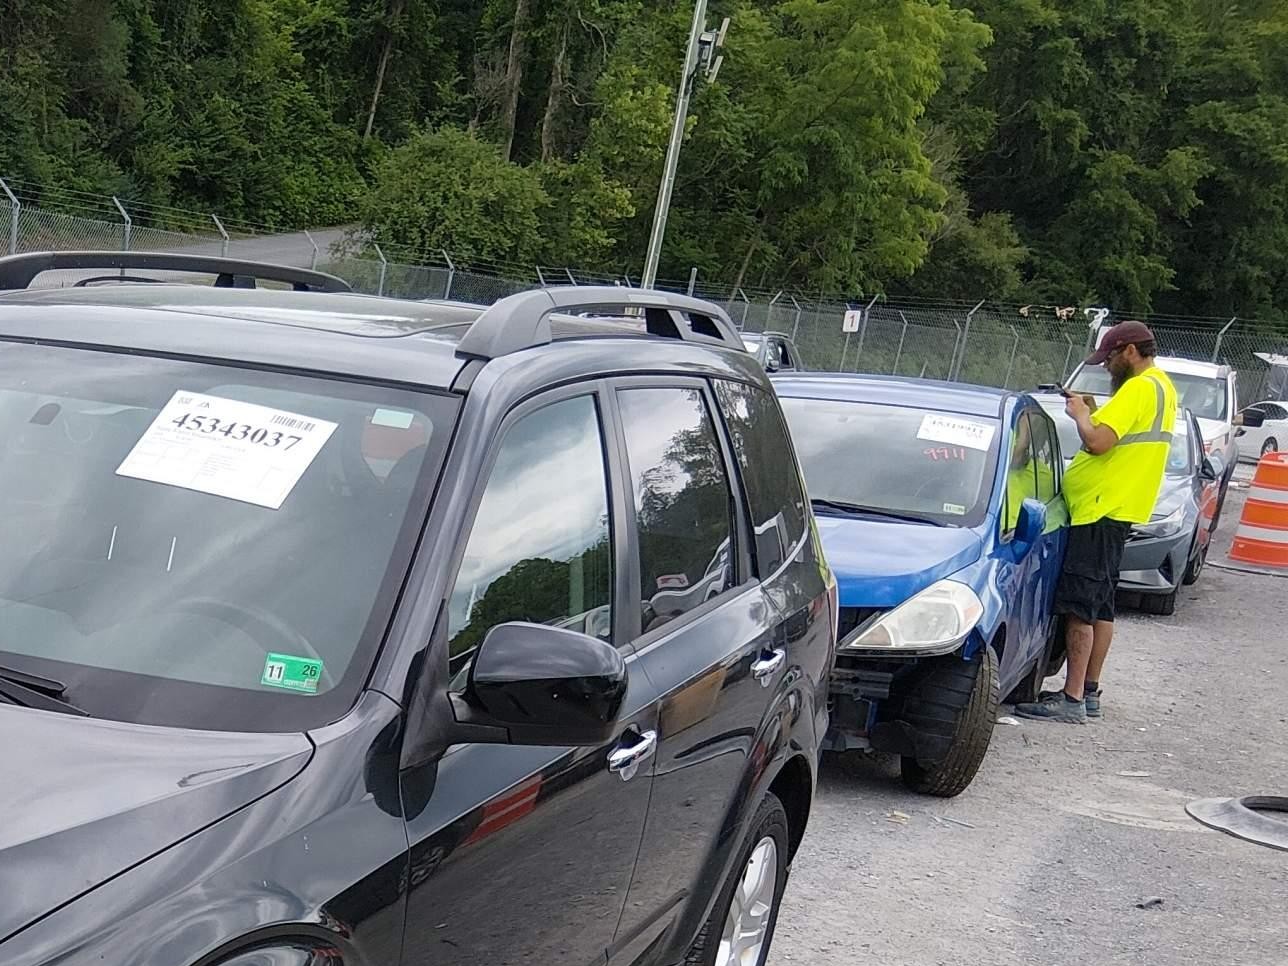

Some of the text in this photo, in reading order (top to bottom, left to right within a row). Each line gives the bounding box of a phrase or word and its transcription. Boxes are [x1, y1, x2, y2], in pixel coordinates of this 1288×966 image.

[171, 411, 303, 452] 45343037
[268, 664, 318, 679] 11 26
